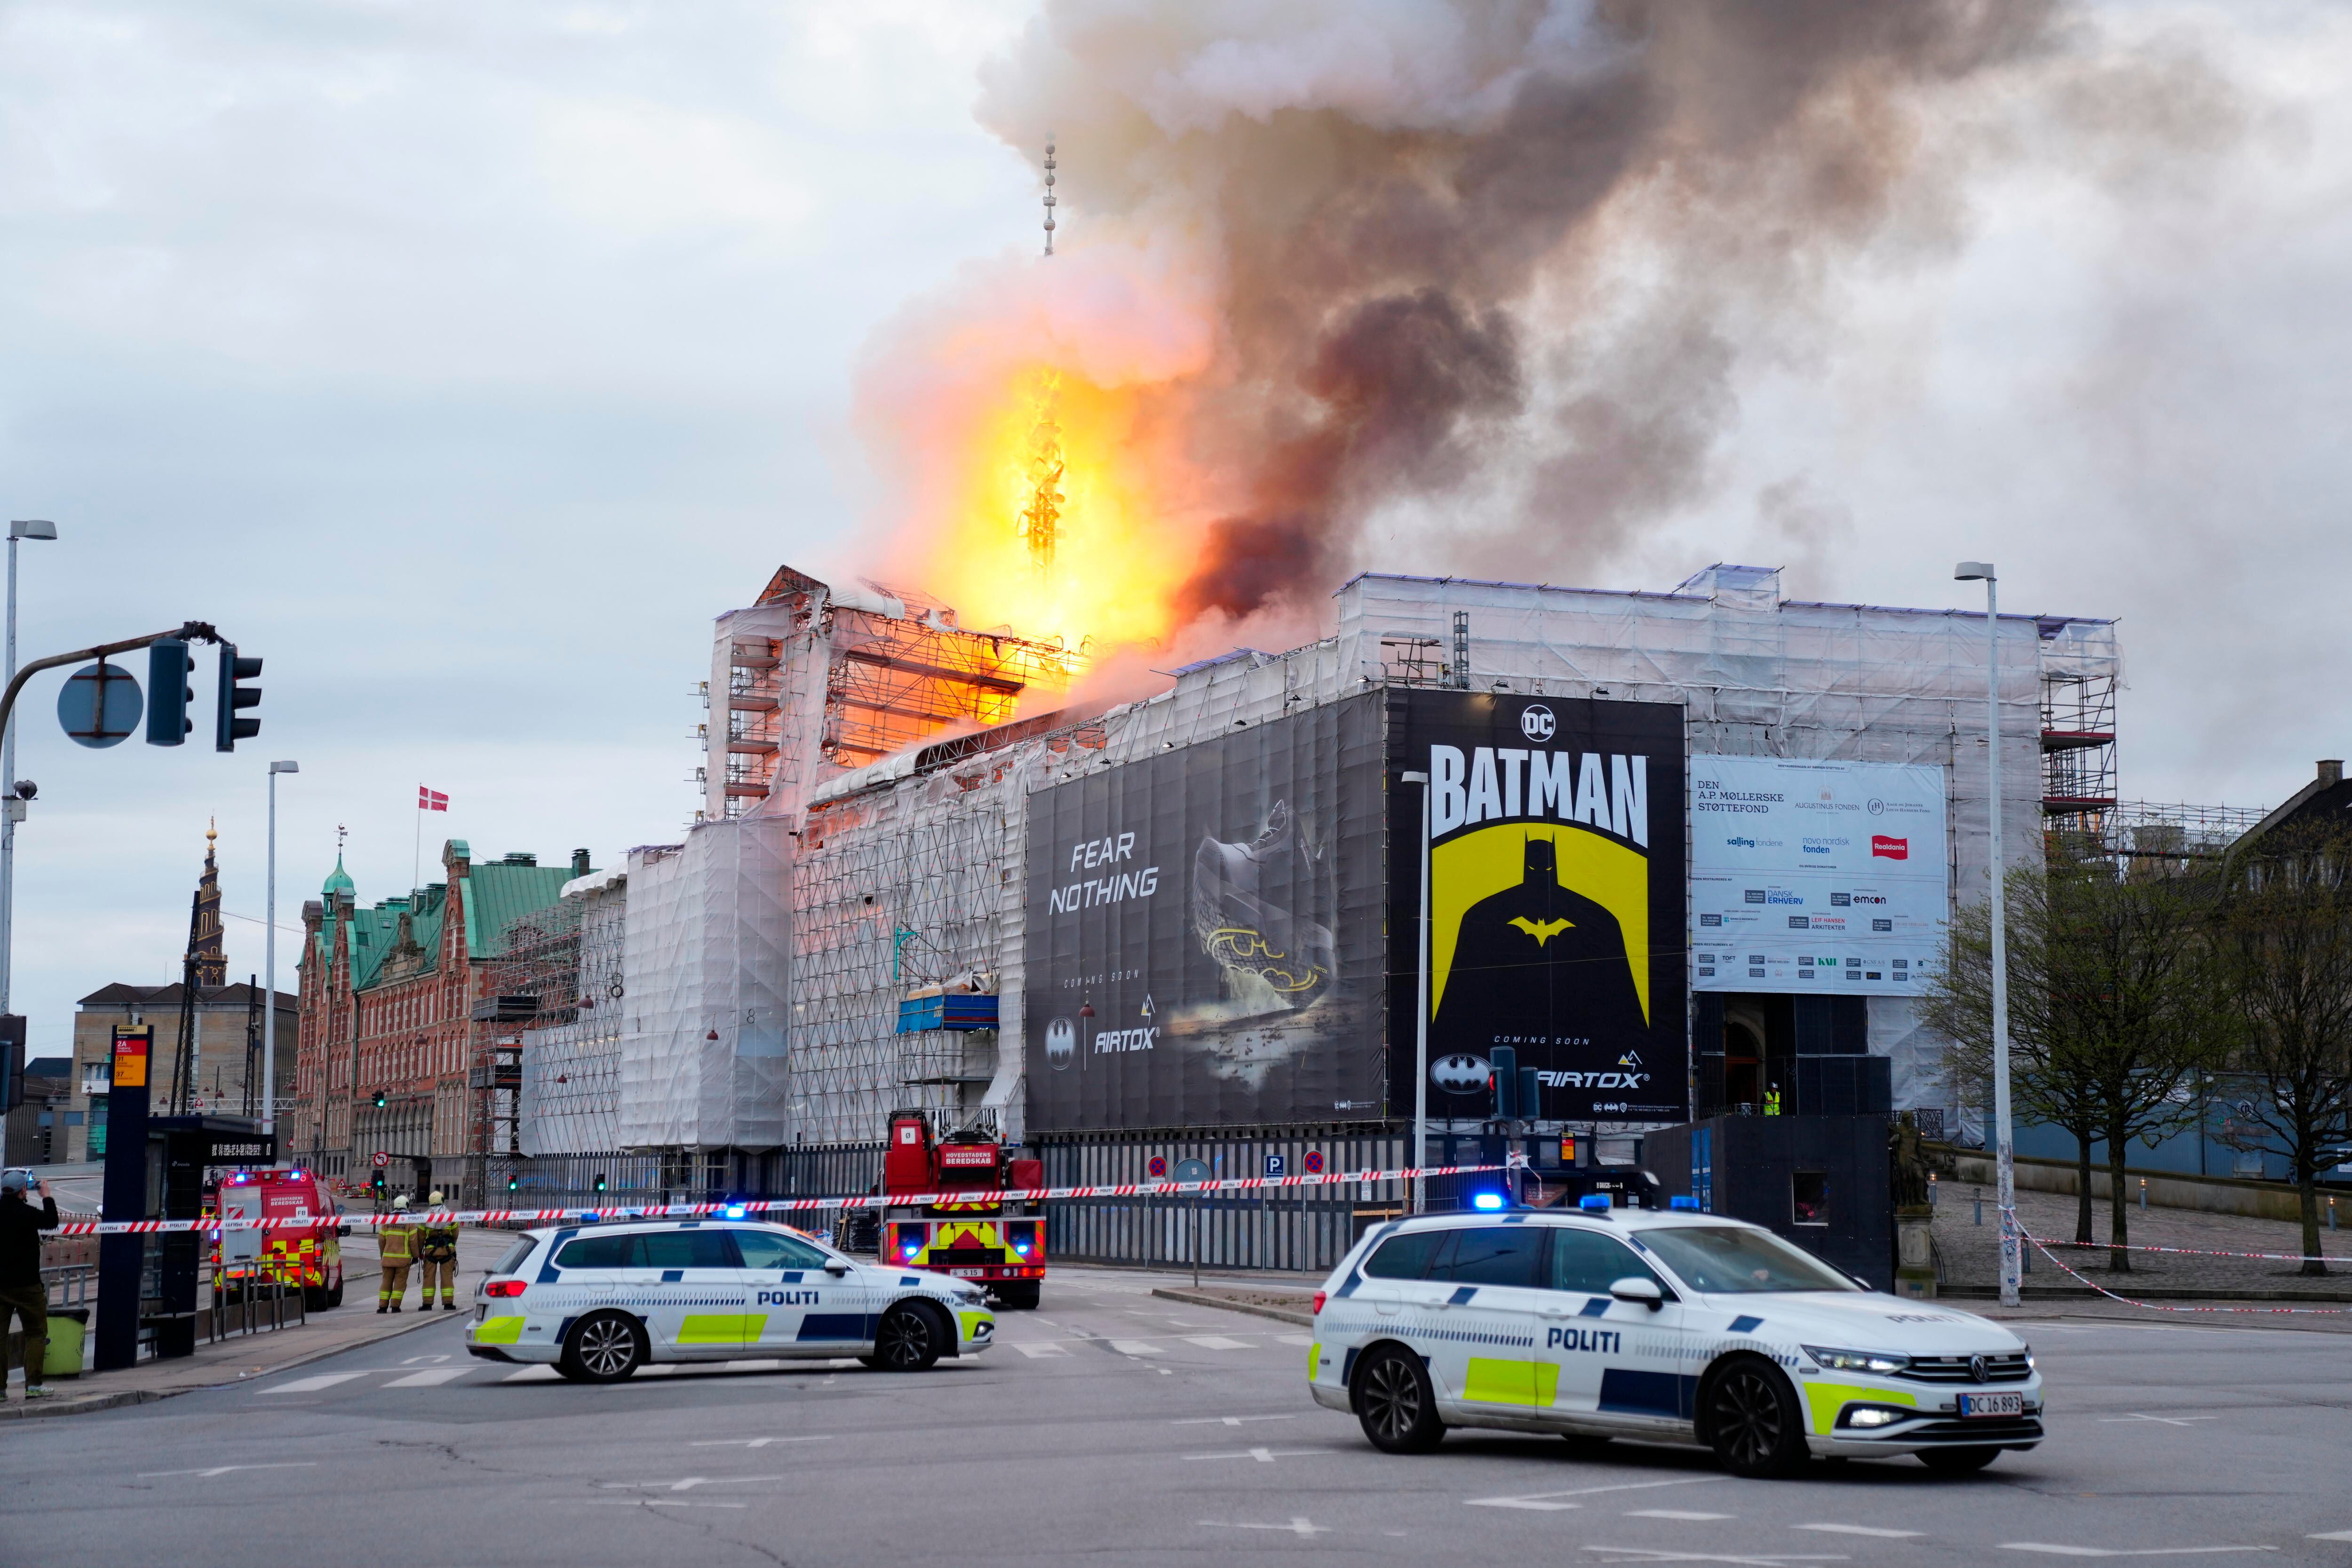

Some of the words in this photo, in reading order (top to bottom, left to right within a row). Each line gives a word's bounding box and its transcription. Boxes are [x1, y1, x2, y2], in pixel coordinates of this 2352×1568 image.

[1524, 713, 1553, 734] DC
[1431, 744, 1648, 849] BATMAN
[1720, 792, 1784, 802] MØLLERSKE
[1698, 803, 1769, 813] STØTTEFOND
[1727, 837, 1755, 848] salling
[1756, 838, 1783, 847] fondene
[1803, 845, 1830, 853] fonden
[1071, 832, 1135, 872] FEAR
[1049, 867, 1159, 915] NOTHING
[1853, 896, 1886, 904] emcon
[1064, 975, 1102, 989] COMING
[1111, 969, 1139, 981] SOON
[1494, 1035, 1547, 1044] COMING
[1270, 1158, 1280, 1172] P
[757, 1291, 819, 1306] POLITI
[1547, 1327, 1621, 1354] POLITI
[1969, 1398, 1984, 1412] DC
[1987, 1397, 1999, 1412] 16
[2002, 1397, 2019, 1412] 893
